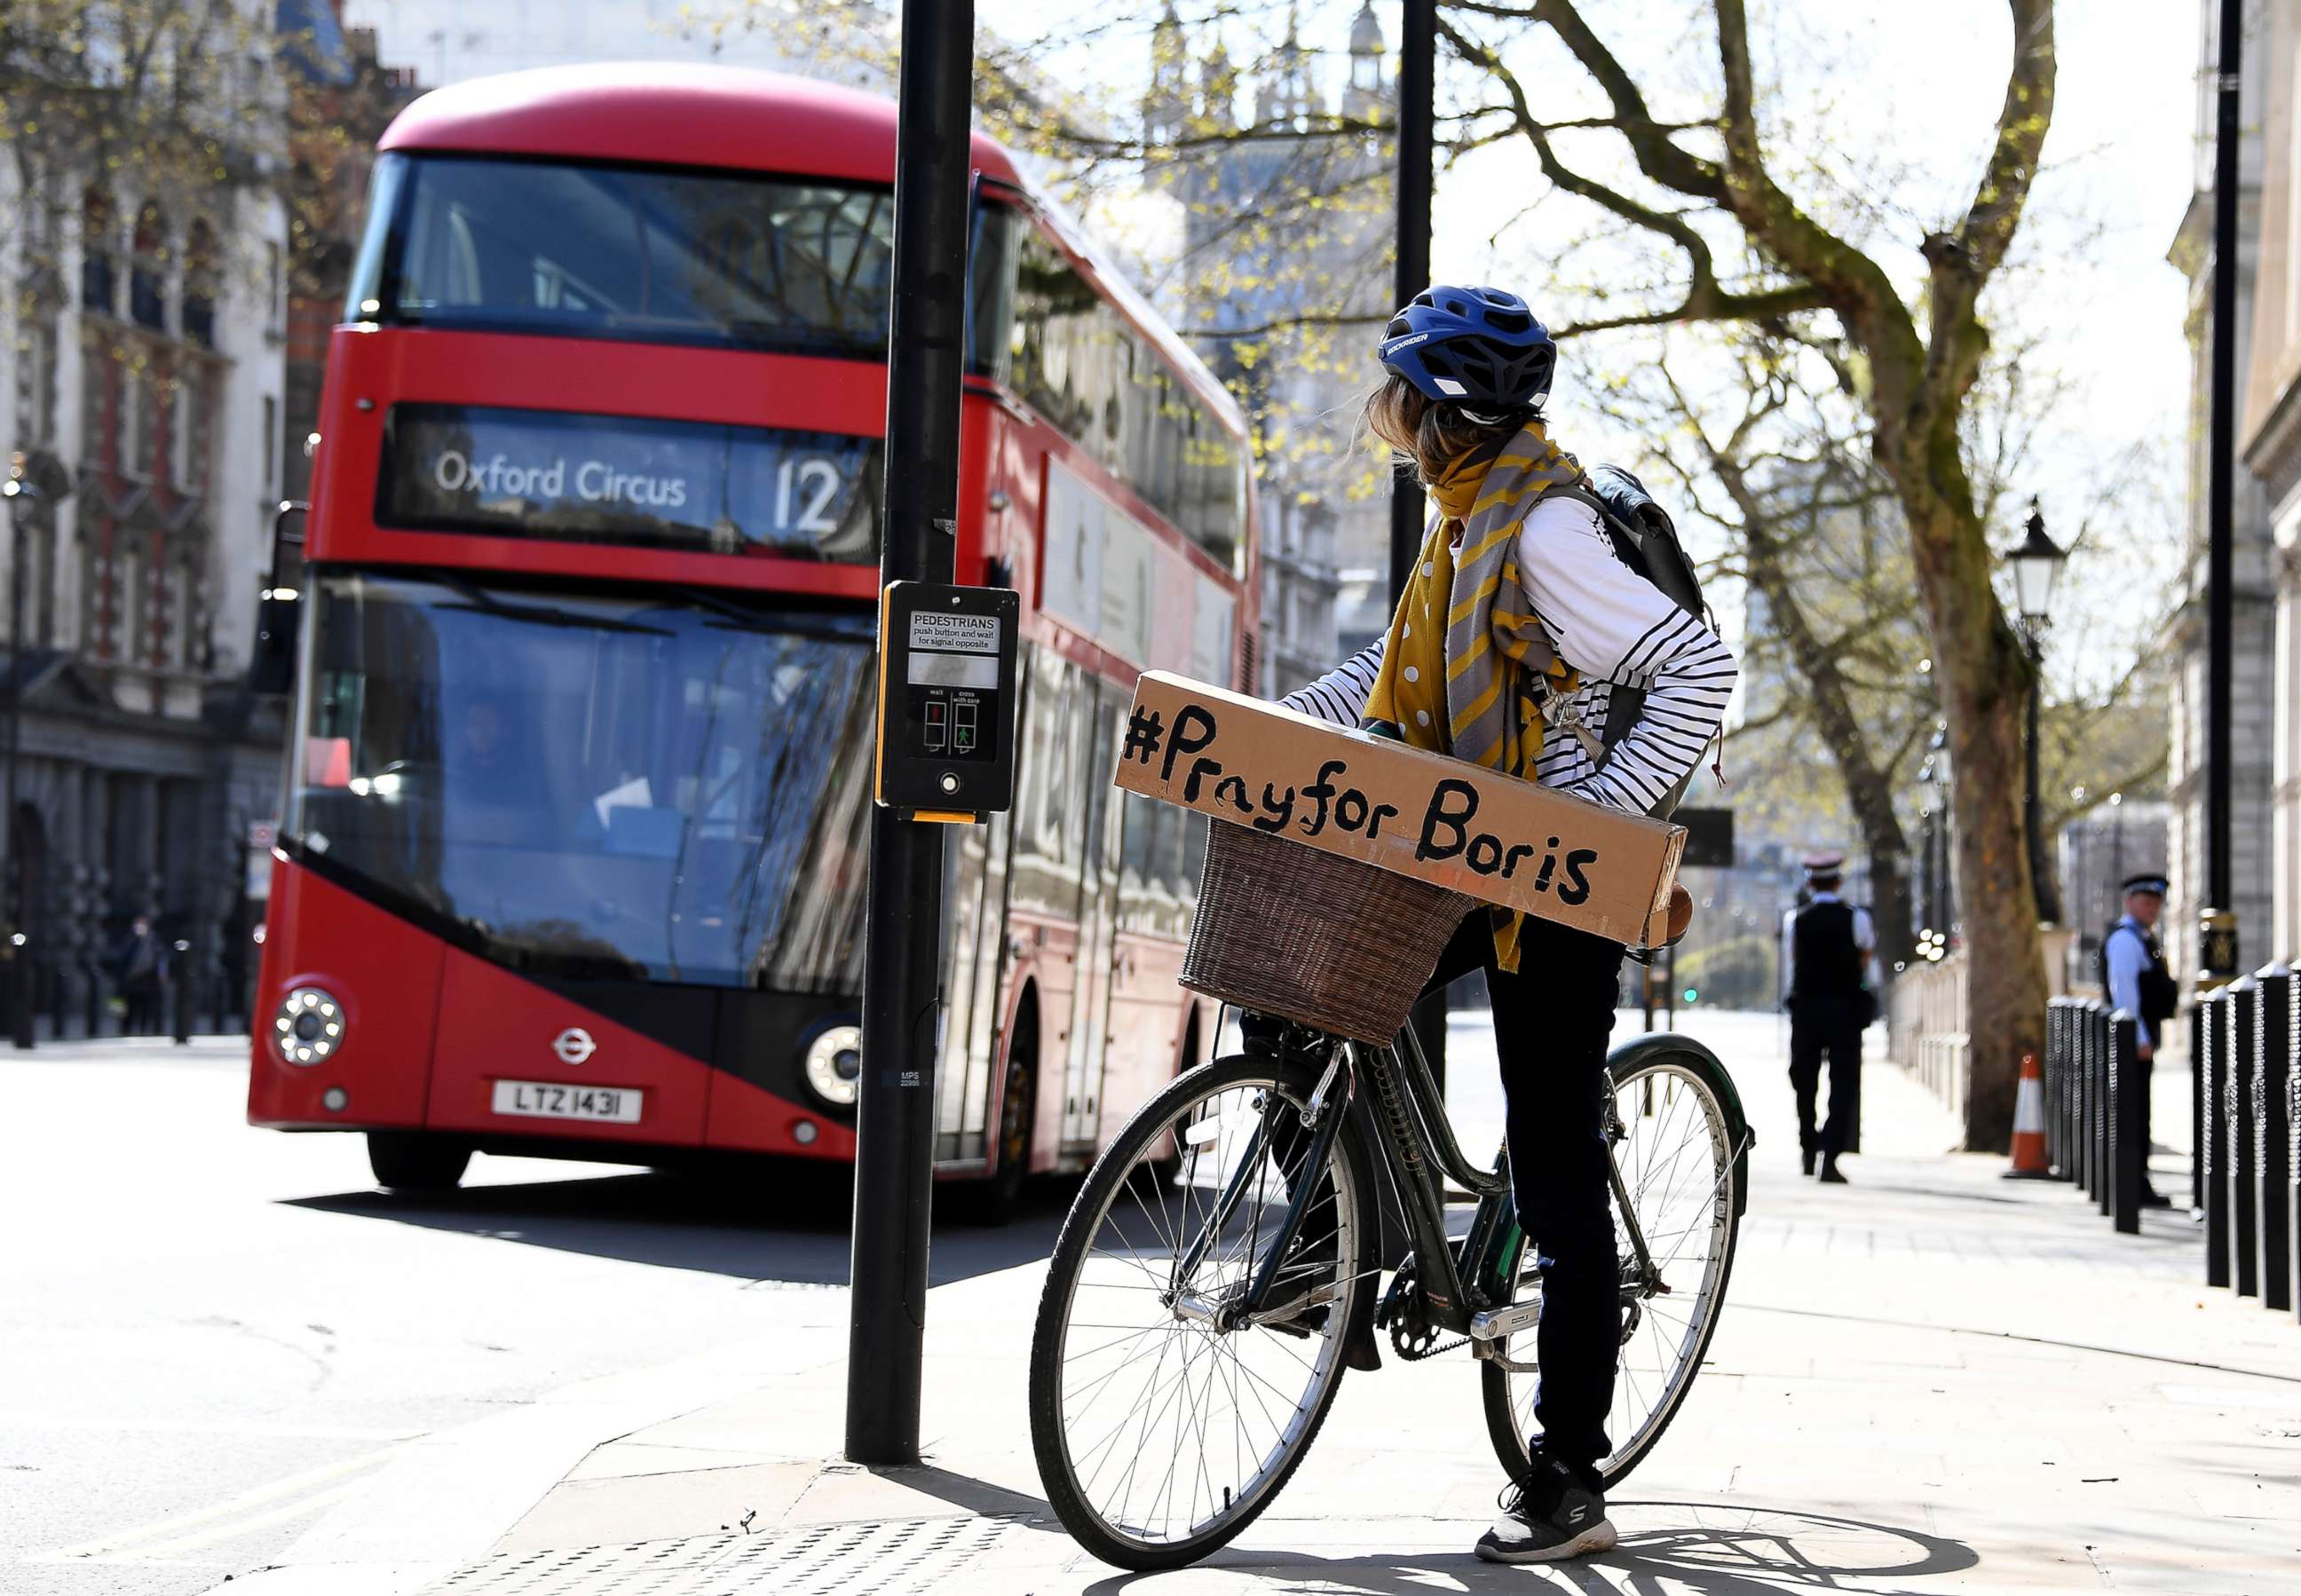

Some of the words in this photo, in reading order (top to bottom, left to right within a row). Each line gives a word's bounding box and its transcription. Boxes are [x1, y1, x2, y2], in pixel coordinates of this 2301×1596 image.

[435, 450, 565, 497] Oxford
[575, 462, 686, 507] Circus
[774, 459, 840, 532] 12
[914, 615, 994, 628] PEDESTRIANS
[935, 628, 960, 637] button
[930, 637, 954, 647] signal
[955, 639, 989, 649] opposite
[1414, 778, 1599, 905] Boris
